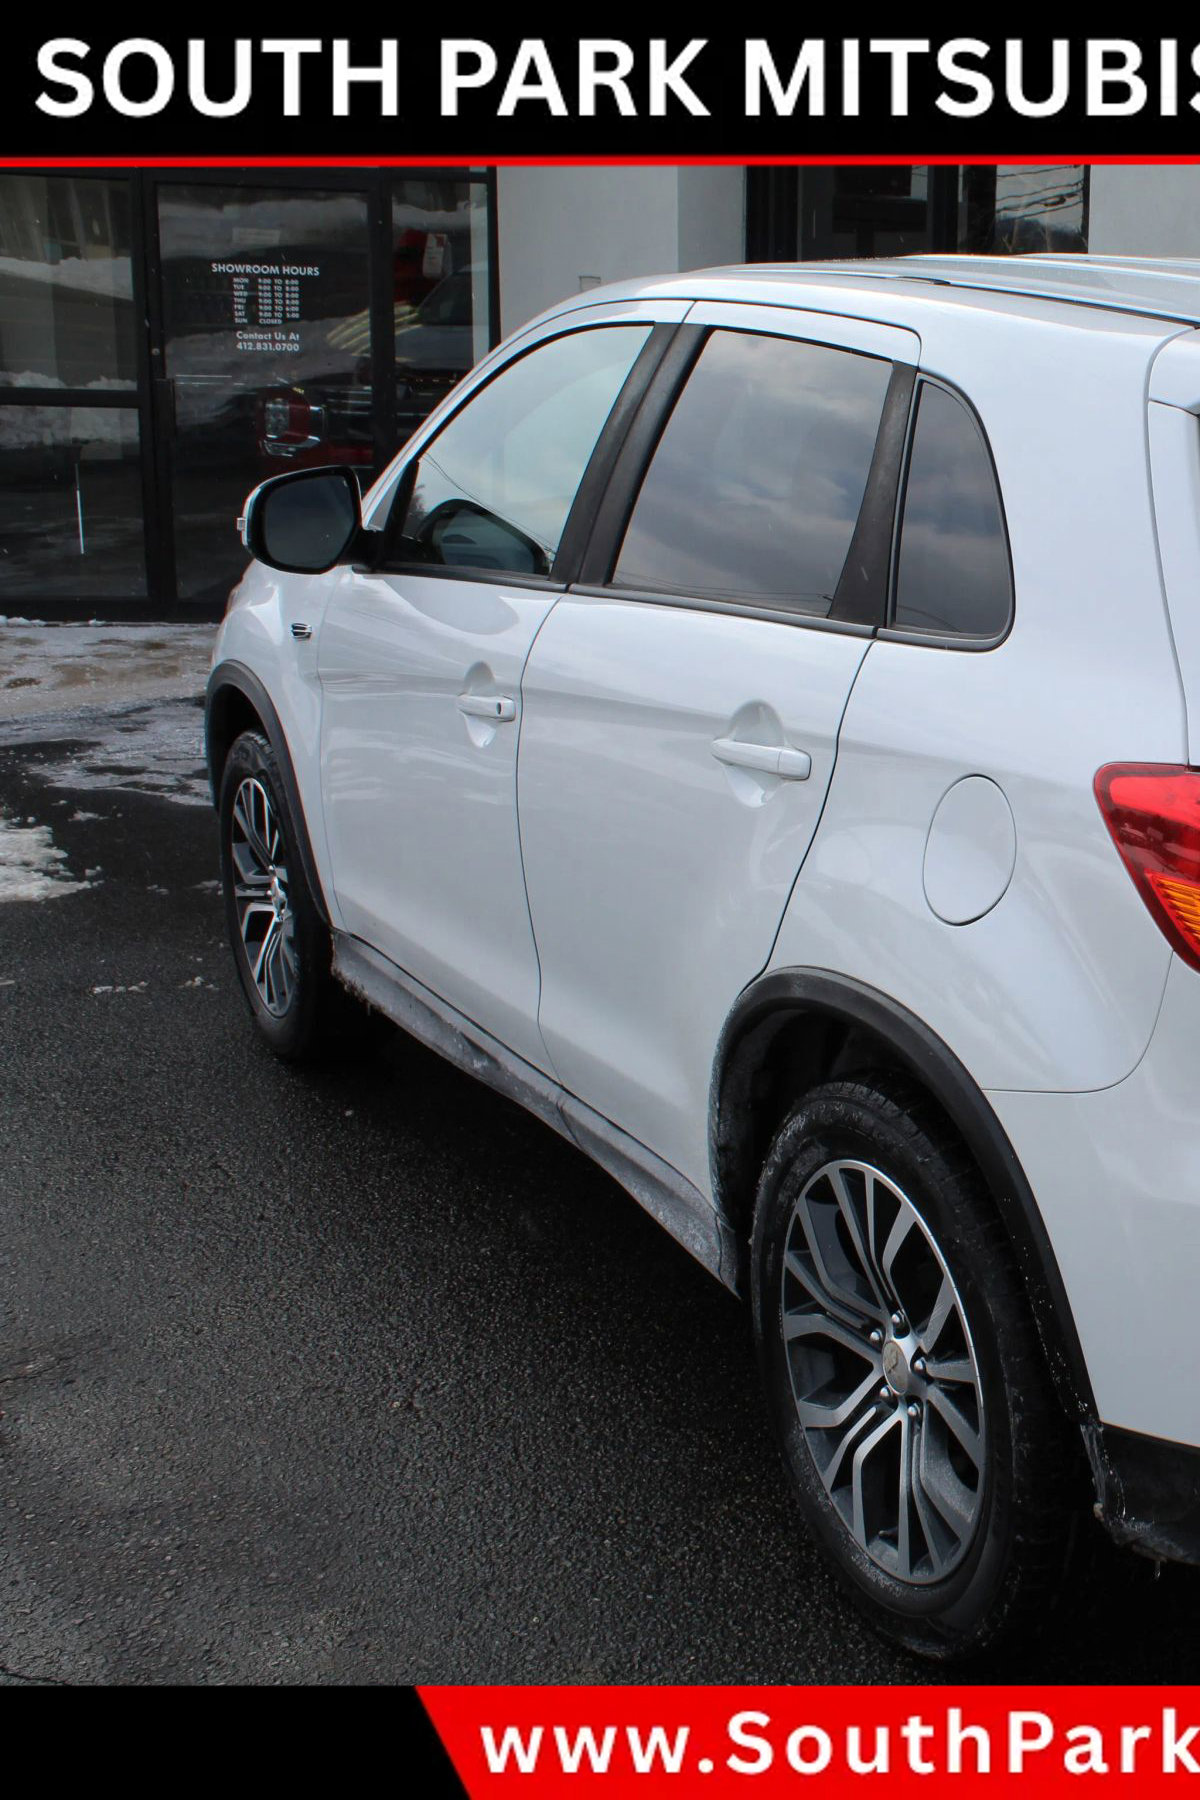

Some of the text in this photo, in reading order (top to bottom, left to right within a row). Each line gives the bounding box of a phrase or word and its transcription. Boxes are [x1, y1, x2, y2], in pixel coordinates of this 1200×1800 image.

[211, 263, 320, 276] SHOWROOM HOURS
[236, 331, 300, 341] Contact Us At
[236, 342, 300, 352] 412.831.0700
